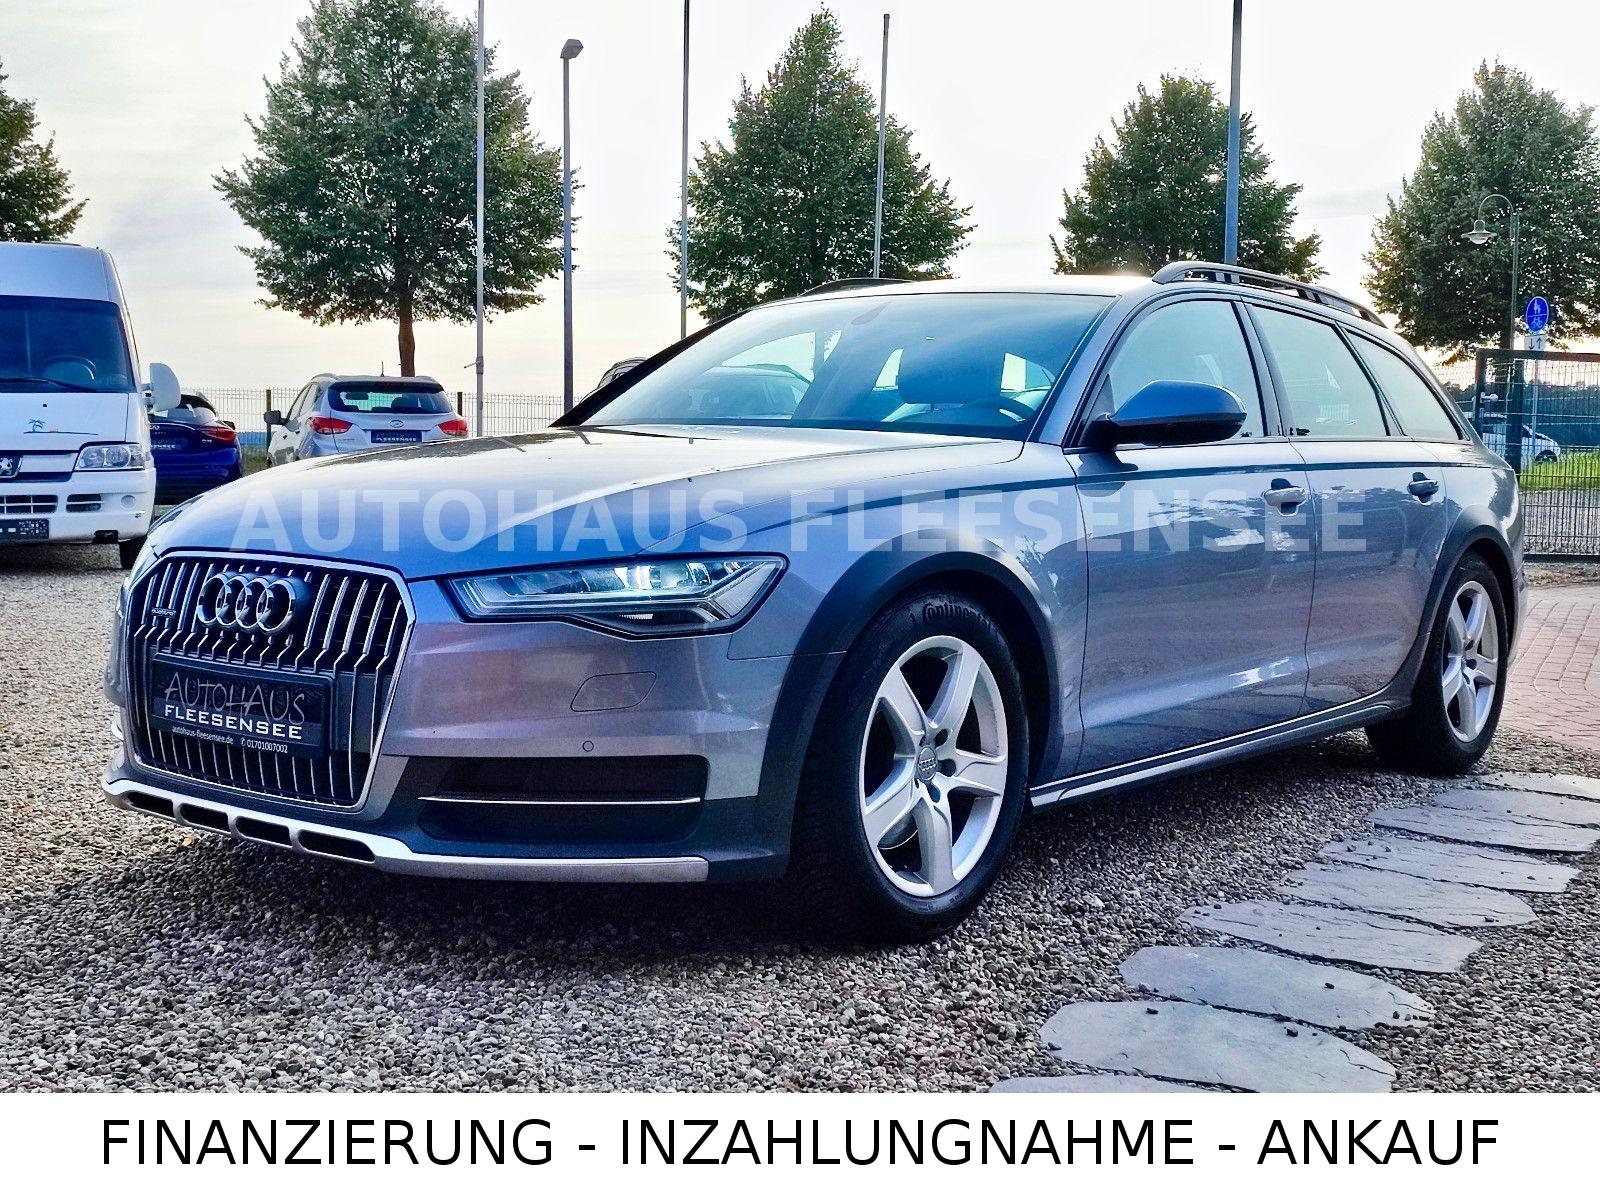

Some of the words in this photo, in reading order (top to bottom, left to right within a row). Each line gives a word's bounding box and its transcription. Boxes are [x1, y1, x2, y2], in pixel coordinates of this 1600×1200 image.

[164, 671, 305, 725] AUTOHAUS
[164, 704, 302, 740] FLEESENSEE
[172, 725, 234, 745] autohaus-fleesensee.de
